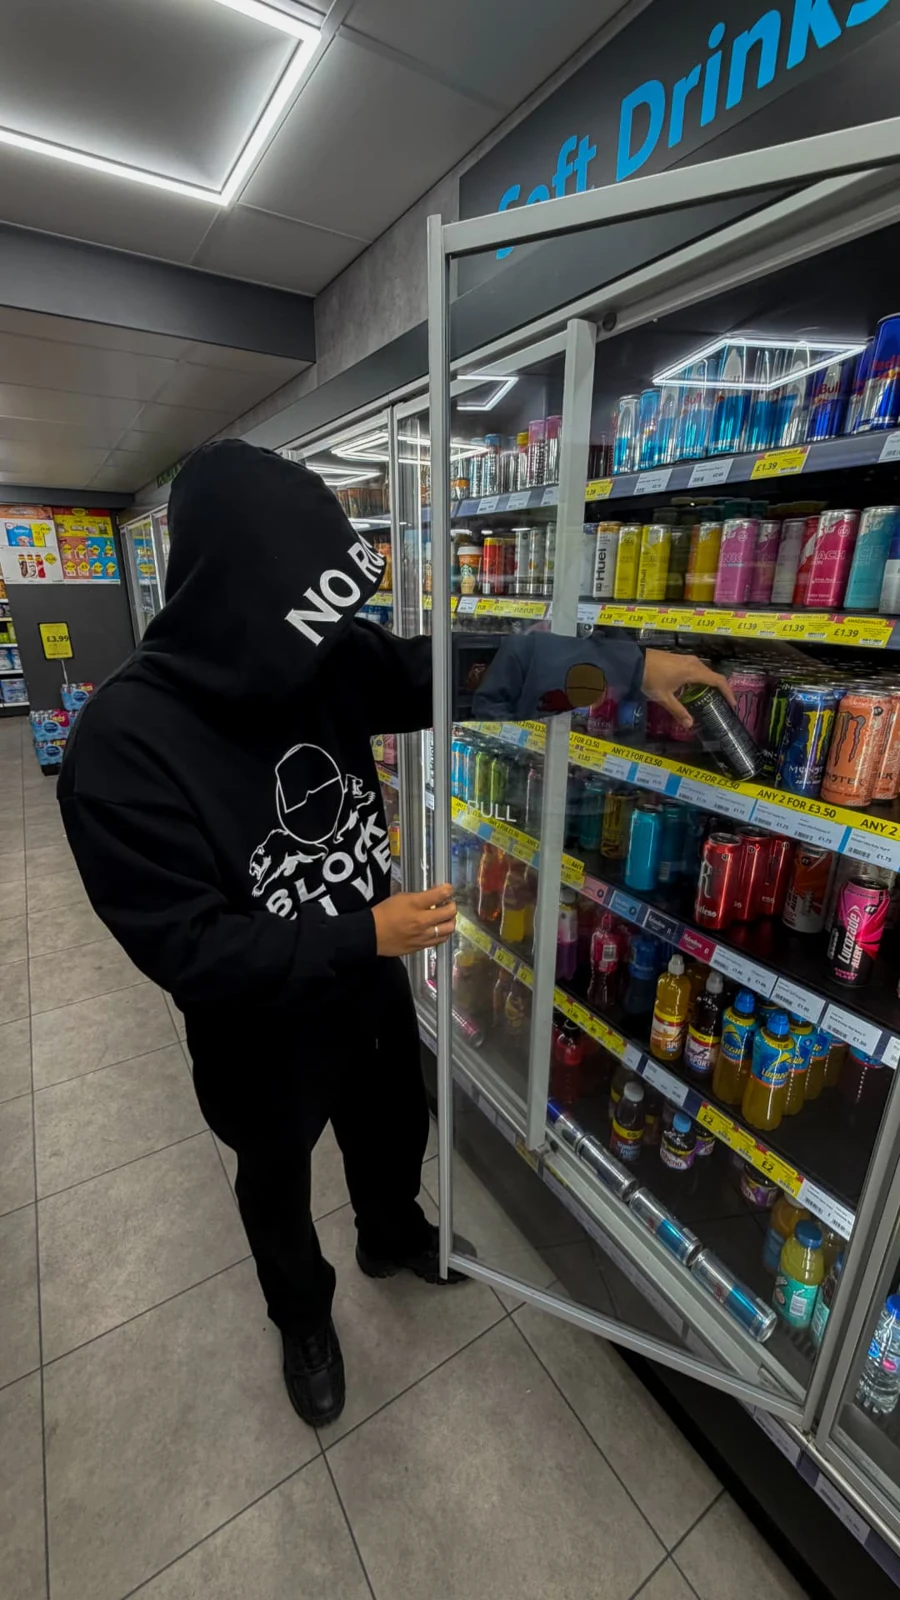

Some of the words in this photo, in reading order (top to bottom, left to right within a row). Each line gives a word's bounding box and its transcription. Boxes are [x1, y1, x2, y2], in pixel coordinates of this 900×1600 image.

[756, 462, 777, 472] £1.39
[596, 548, 607, 580] Huel
[284, 569, 360, 646] NO
[737, 622, 758, 630] £1.39
[782, 624, 805, 632] £1.39
[833, 628, 859, 638] £1.39
[574, 736, 585, 744] FOR
[584, 739, 600, 749] £3.50
[611, 747, 625, 757] ANY
[630, 752, 644, 762] FOR
[644, 756, 663, 767] £3.50
[676, 766, 694, 778] ANY
[694, 770, 700, 778] 2
[700, 772, 717, 784] FOR
[716, 777, 740, 790] £3.50
[467, 800, 517, 822] PULL
[756, 789, 779, 803] ANY
[778, 795, 786, 804] 2
[786, 798, 806, 810] FOR
[808, 804, 837, 819] £3.50
[860, 819, 888, 833] ANY
[888, 826, 898, 836] 2
[818, 836, 832, 844] £1.75
[876, 854, 892, 862] £1.75
[572, 861, 583, 870] ANY
[837, 912, 861, 965] Lucozade
[850, 943, 863, 969] ALERT
[702, 1114, 714, 1126] £2
[761, 1160, 775, 1174] £2
